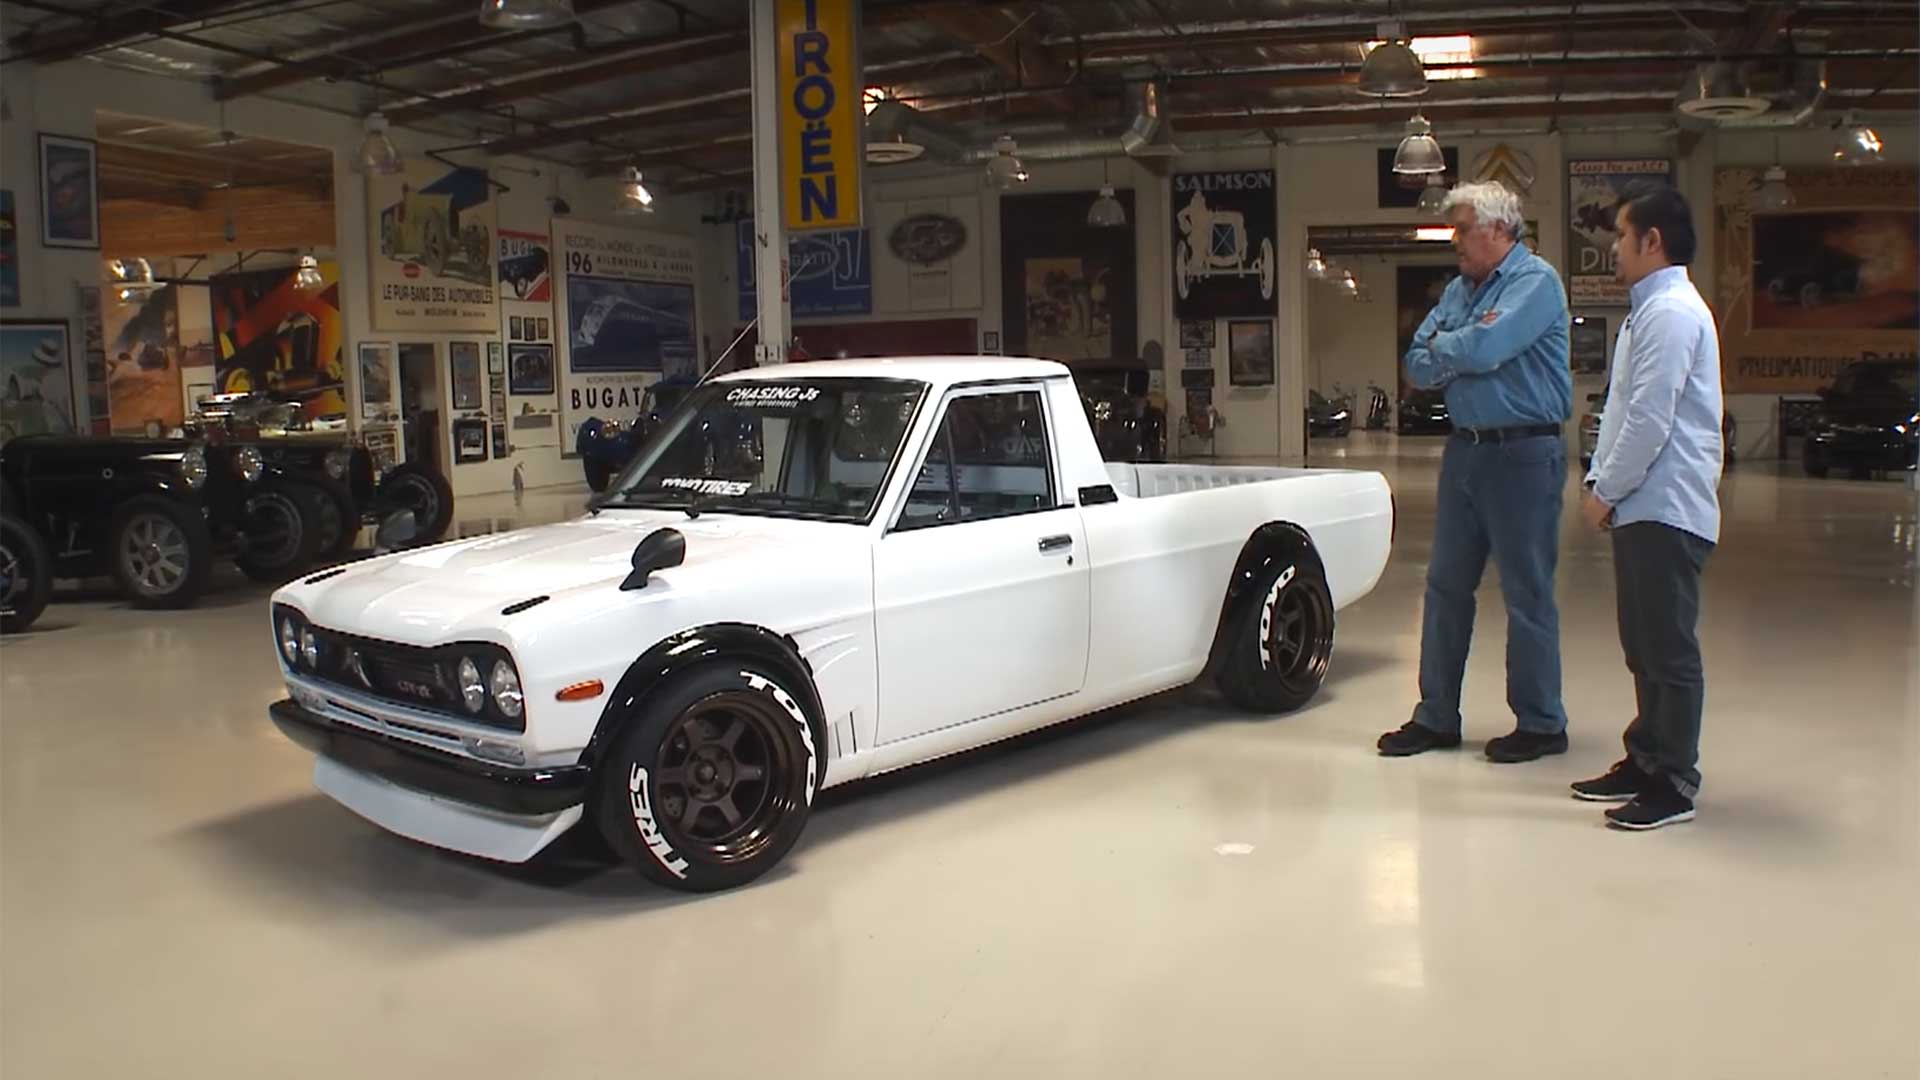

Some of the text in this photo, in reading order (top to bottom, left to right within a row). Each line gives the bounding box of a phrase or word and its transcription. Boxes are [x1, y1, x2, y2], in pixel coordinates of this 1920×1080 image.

[1176, 173, 1271, 192] SALMSON
[566, 251, 592, 273] 196
[383, 285, 392, 301] LE
[432, 287, 445, 302] DES
[448, 288, 493, 304] AUTOMOBILES
[726, 386, 802, 401] CHASING
[698, 480, 752, 496] TIRES
[1259, 565, 1296, 671] TOYO
[740, 670, 818, 808] TOYO
[629, 761, 690, 880] TIRES
